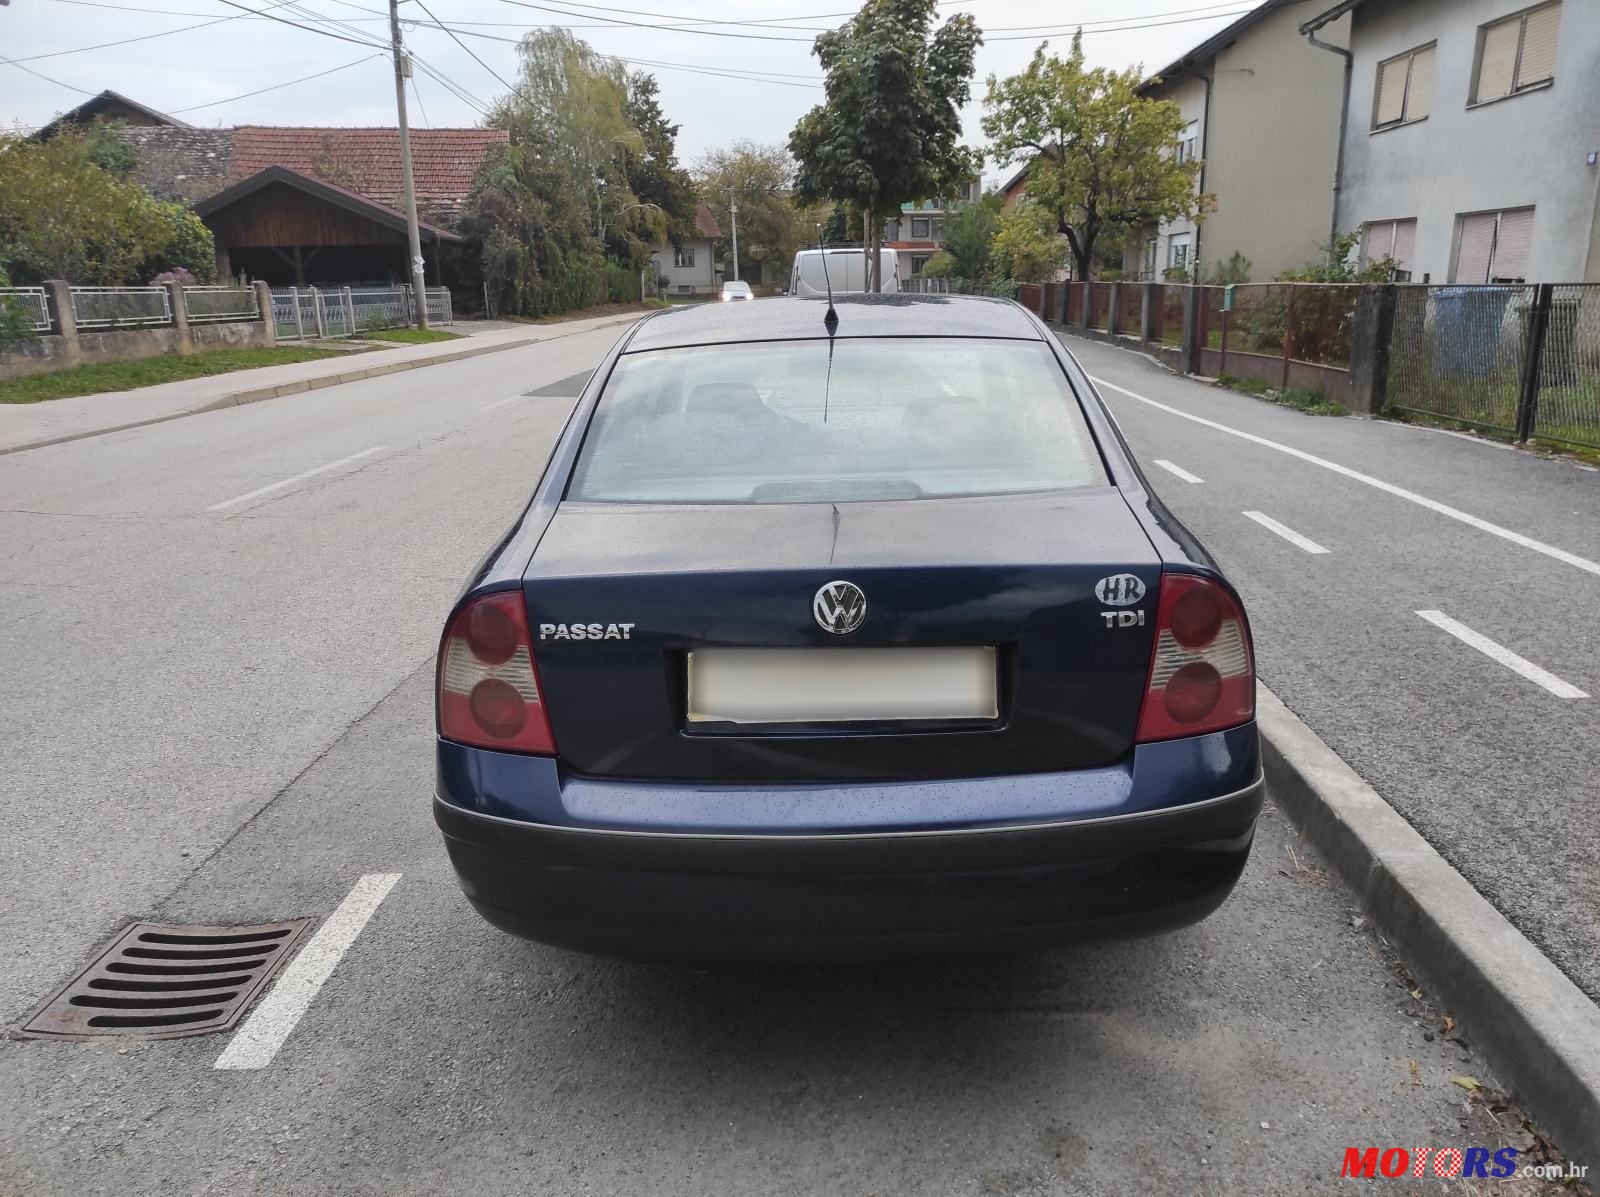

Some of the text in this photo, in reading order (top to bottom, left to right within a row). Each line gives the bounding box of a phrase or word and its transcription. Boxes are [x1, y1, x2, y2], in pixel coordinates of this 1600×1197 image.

[1103, 577, 1141, 601] HR
[814, 580, 866, 634] VW
[1100, 609, 1145, 628] TDI
[540, 623, 635, 640] PASSAT
